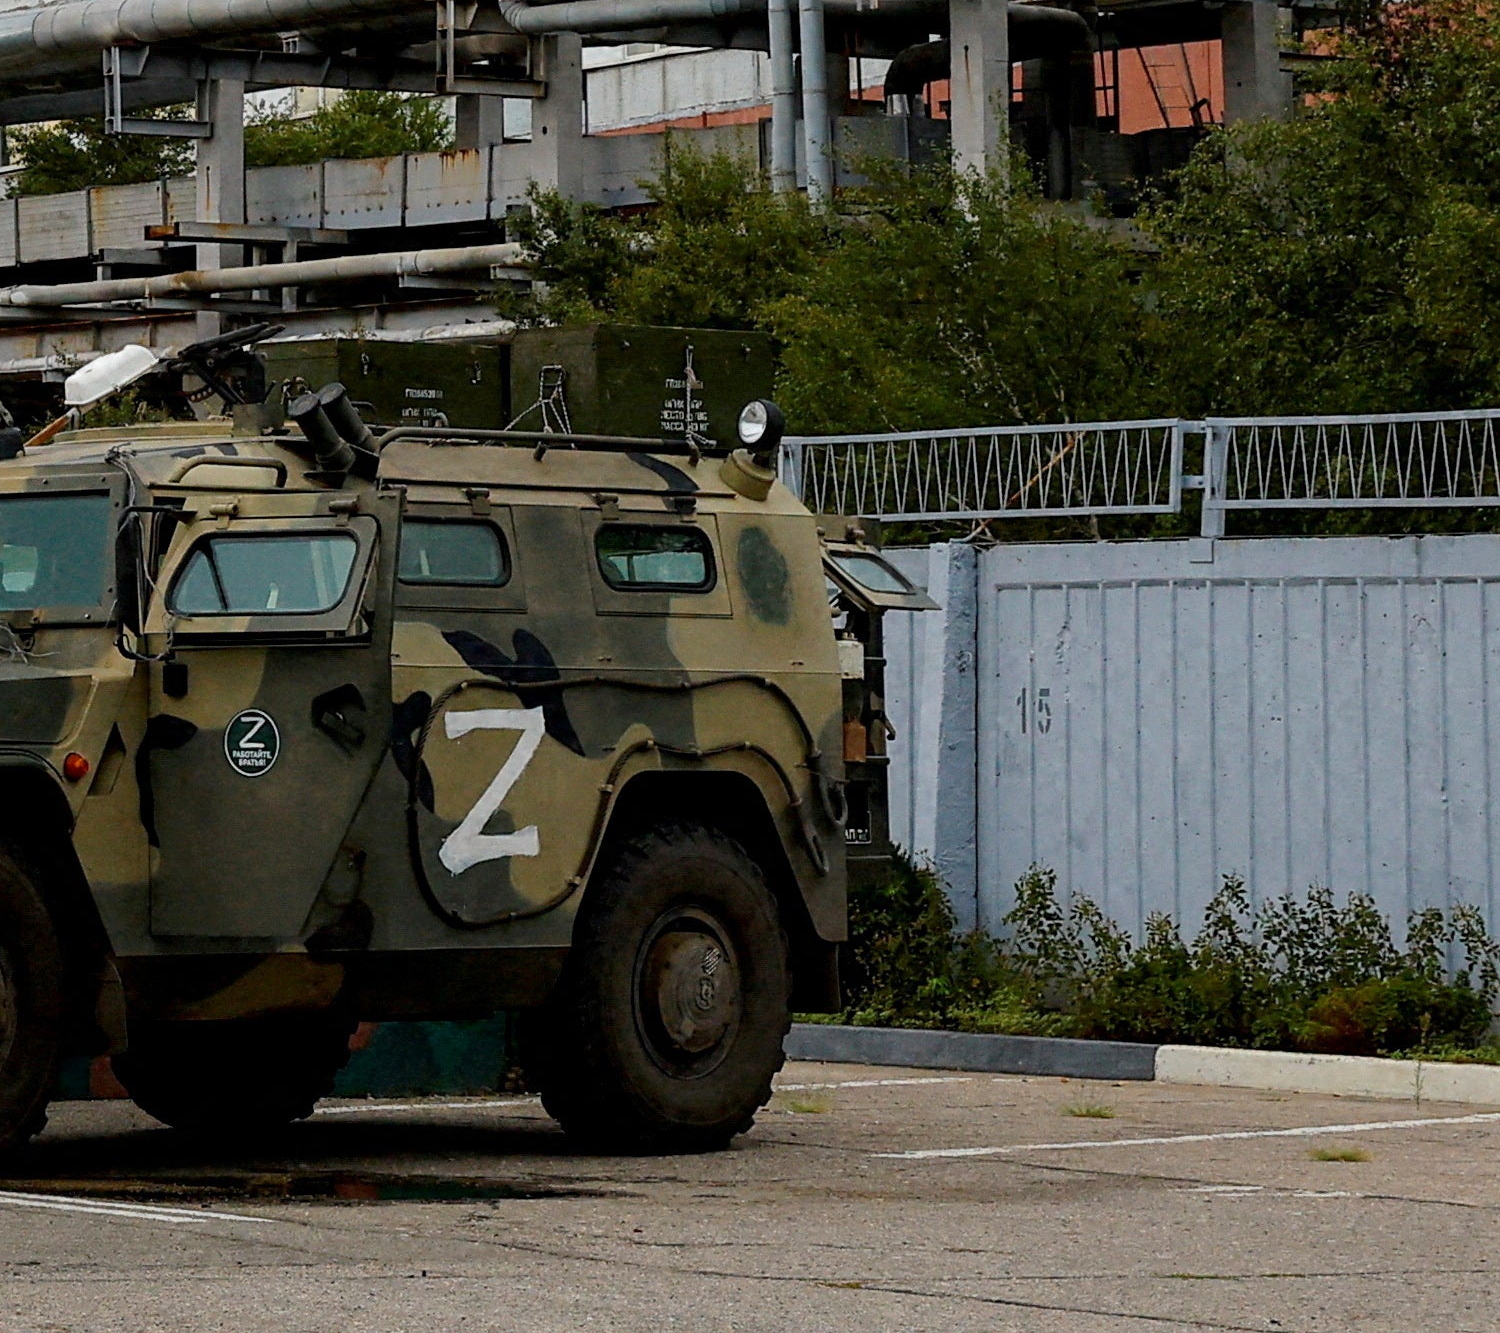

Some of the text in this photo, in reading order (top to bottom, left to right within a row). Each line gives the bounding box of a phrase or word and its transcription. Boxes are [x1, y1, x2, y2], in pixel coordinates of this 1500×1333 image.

[238, 716, 266, 748] Z
[1016, 687, 1052, 734] 15
[439, 705, 546, 876] Z
